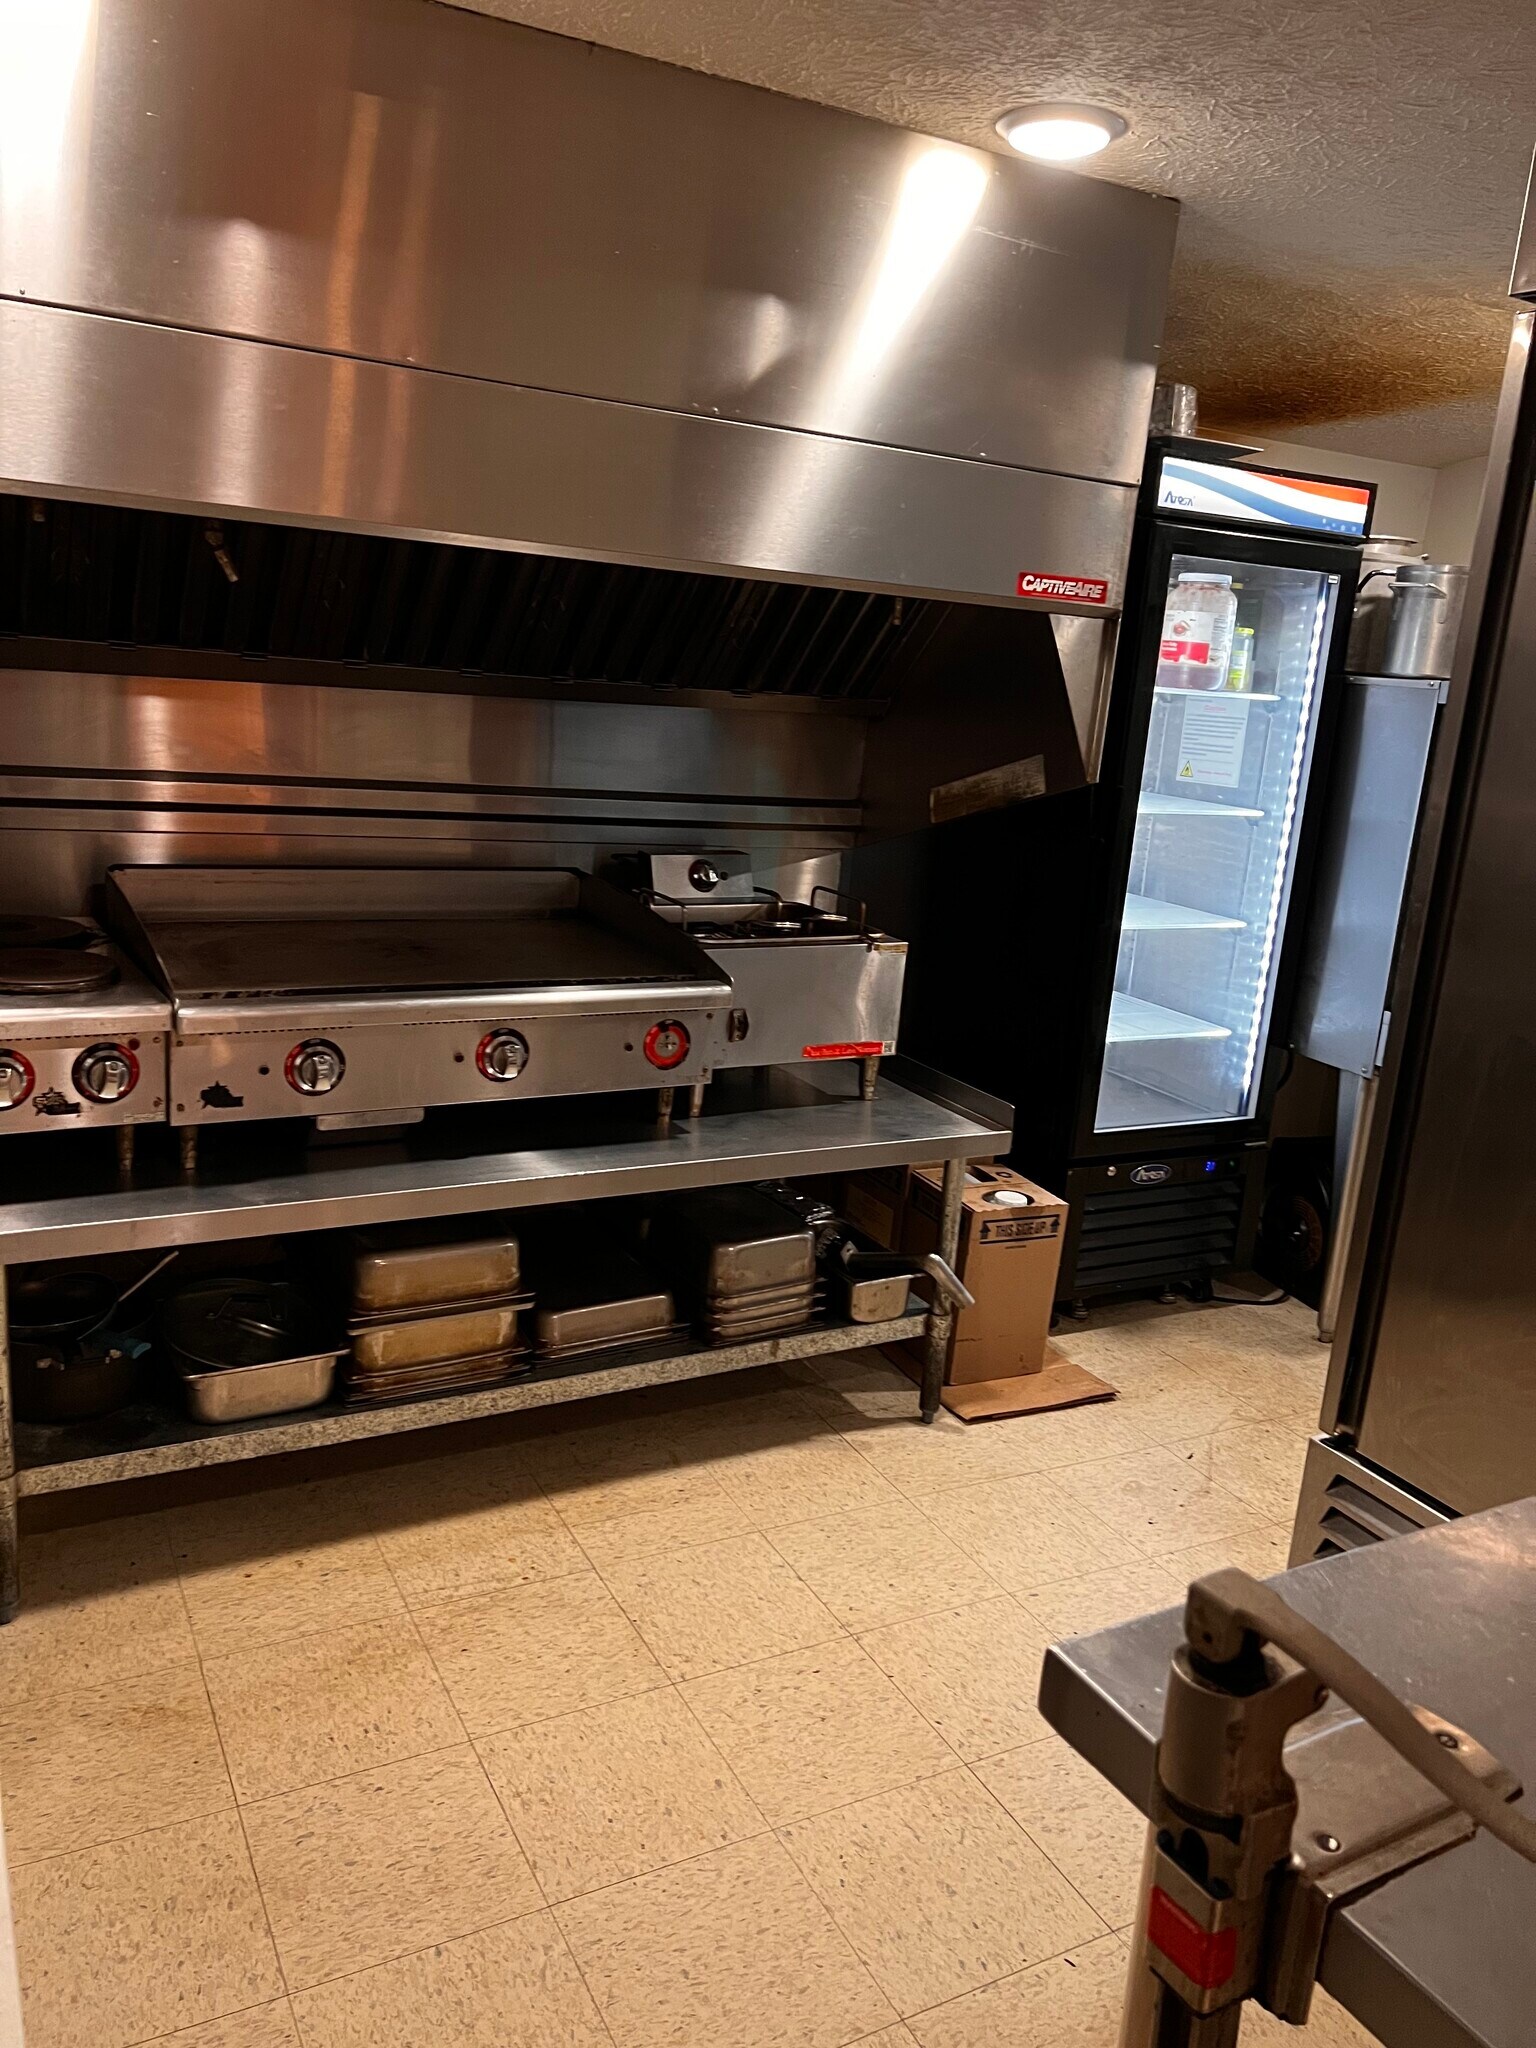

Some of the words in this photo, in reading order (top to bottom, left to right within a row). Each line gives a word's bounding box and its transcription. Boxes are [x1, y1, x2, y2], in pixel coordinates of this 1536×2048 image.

[996, 1224, 1013, 1237] THIS
[1015, 1222, 1034, 1236] SIDE
[1035, 1221, 1046, 1234] UP
